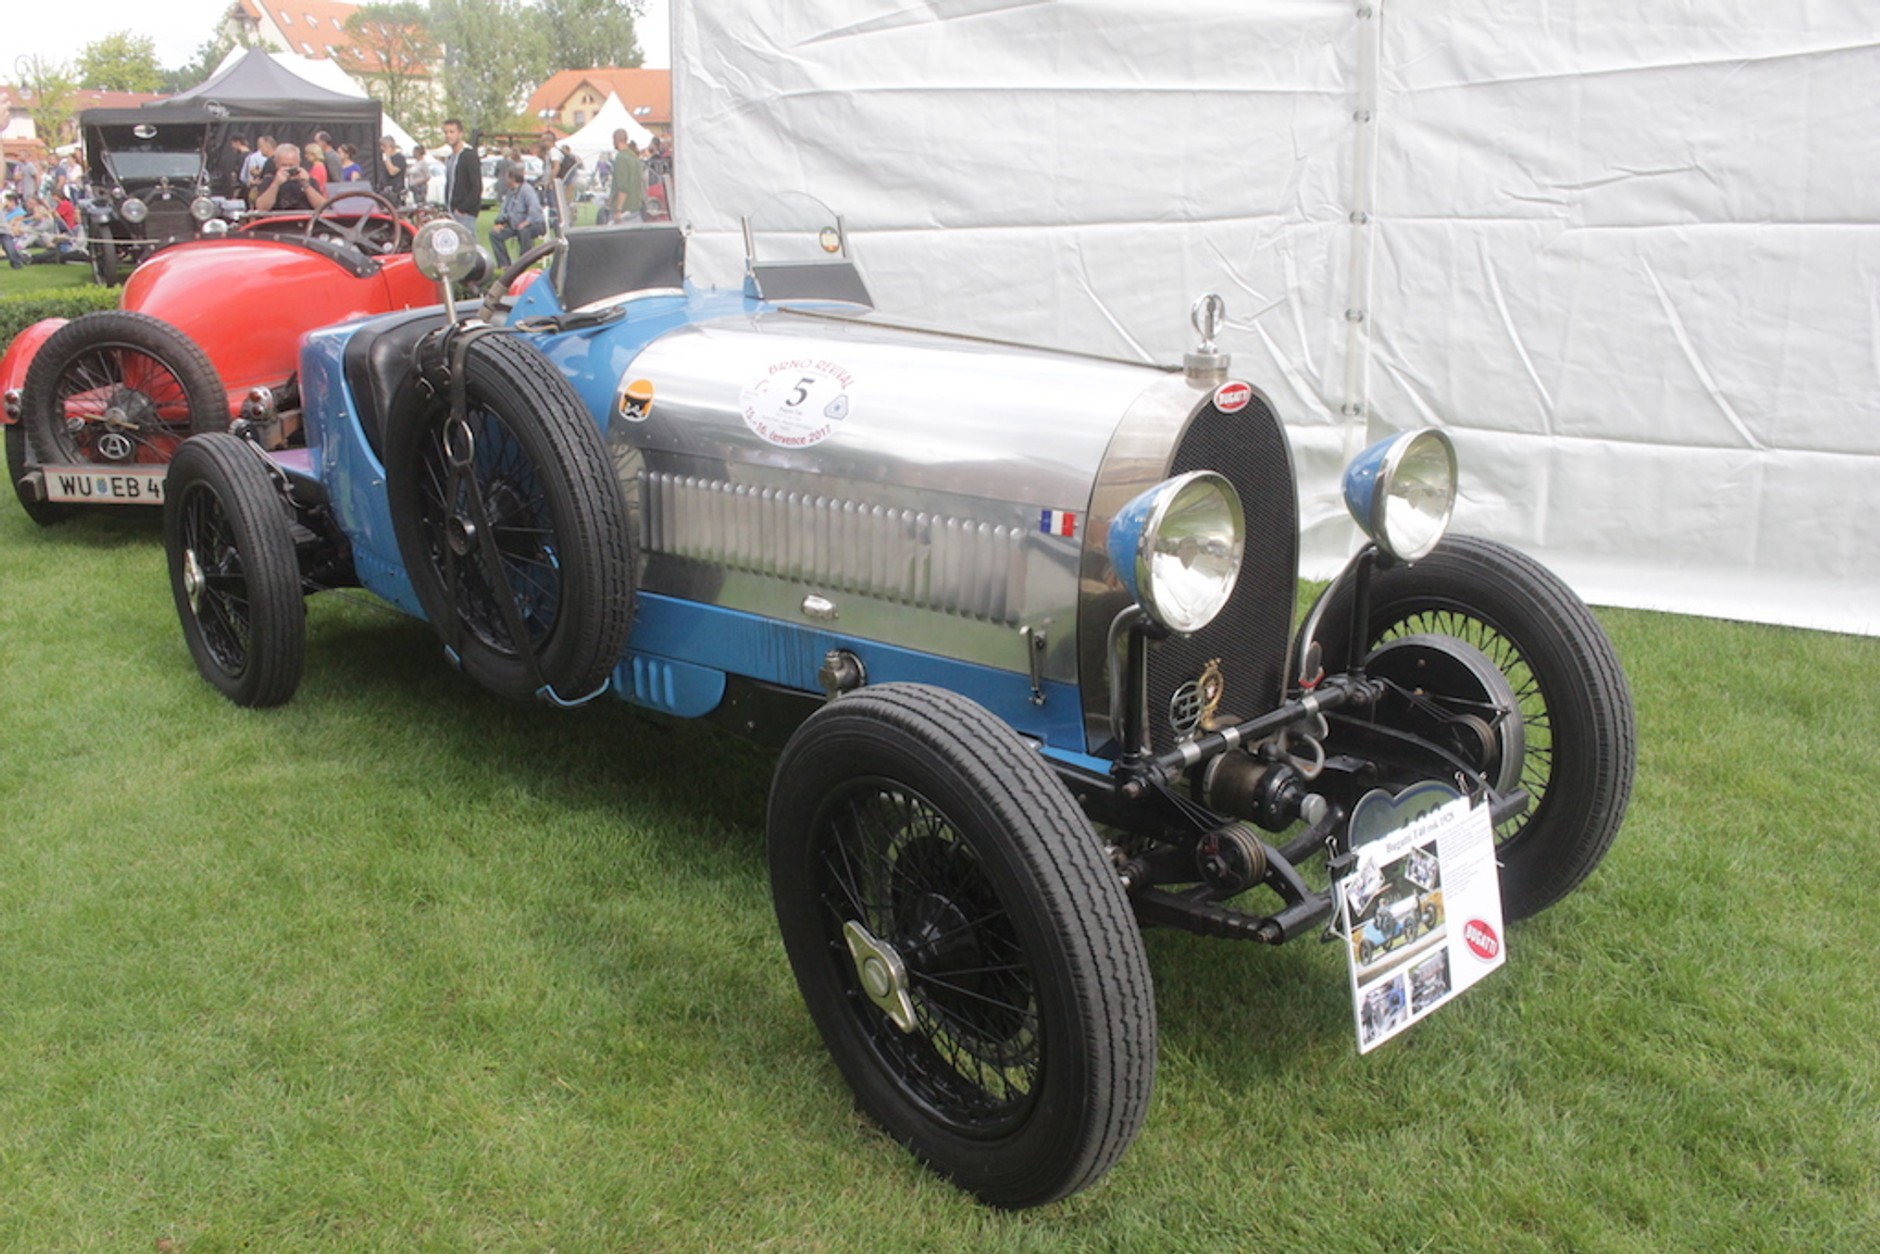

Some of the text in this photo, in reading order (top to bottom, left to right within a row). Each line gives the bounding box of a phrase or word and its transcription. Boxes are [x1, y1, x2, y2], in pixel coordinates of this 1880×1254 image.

[769, 359, 812, 375] BRNO
[815, 360, 855, 390] REVIVAL
[785, 377, 815, 407] 5
[808, 424, 832, 443] 2017
[59, 475, 92, 496] WU
[111, 477, 140, 498] EB
[1465, 924, 1497, 955] BUGATTI
